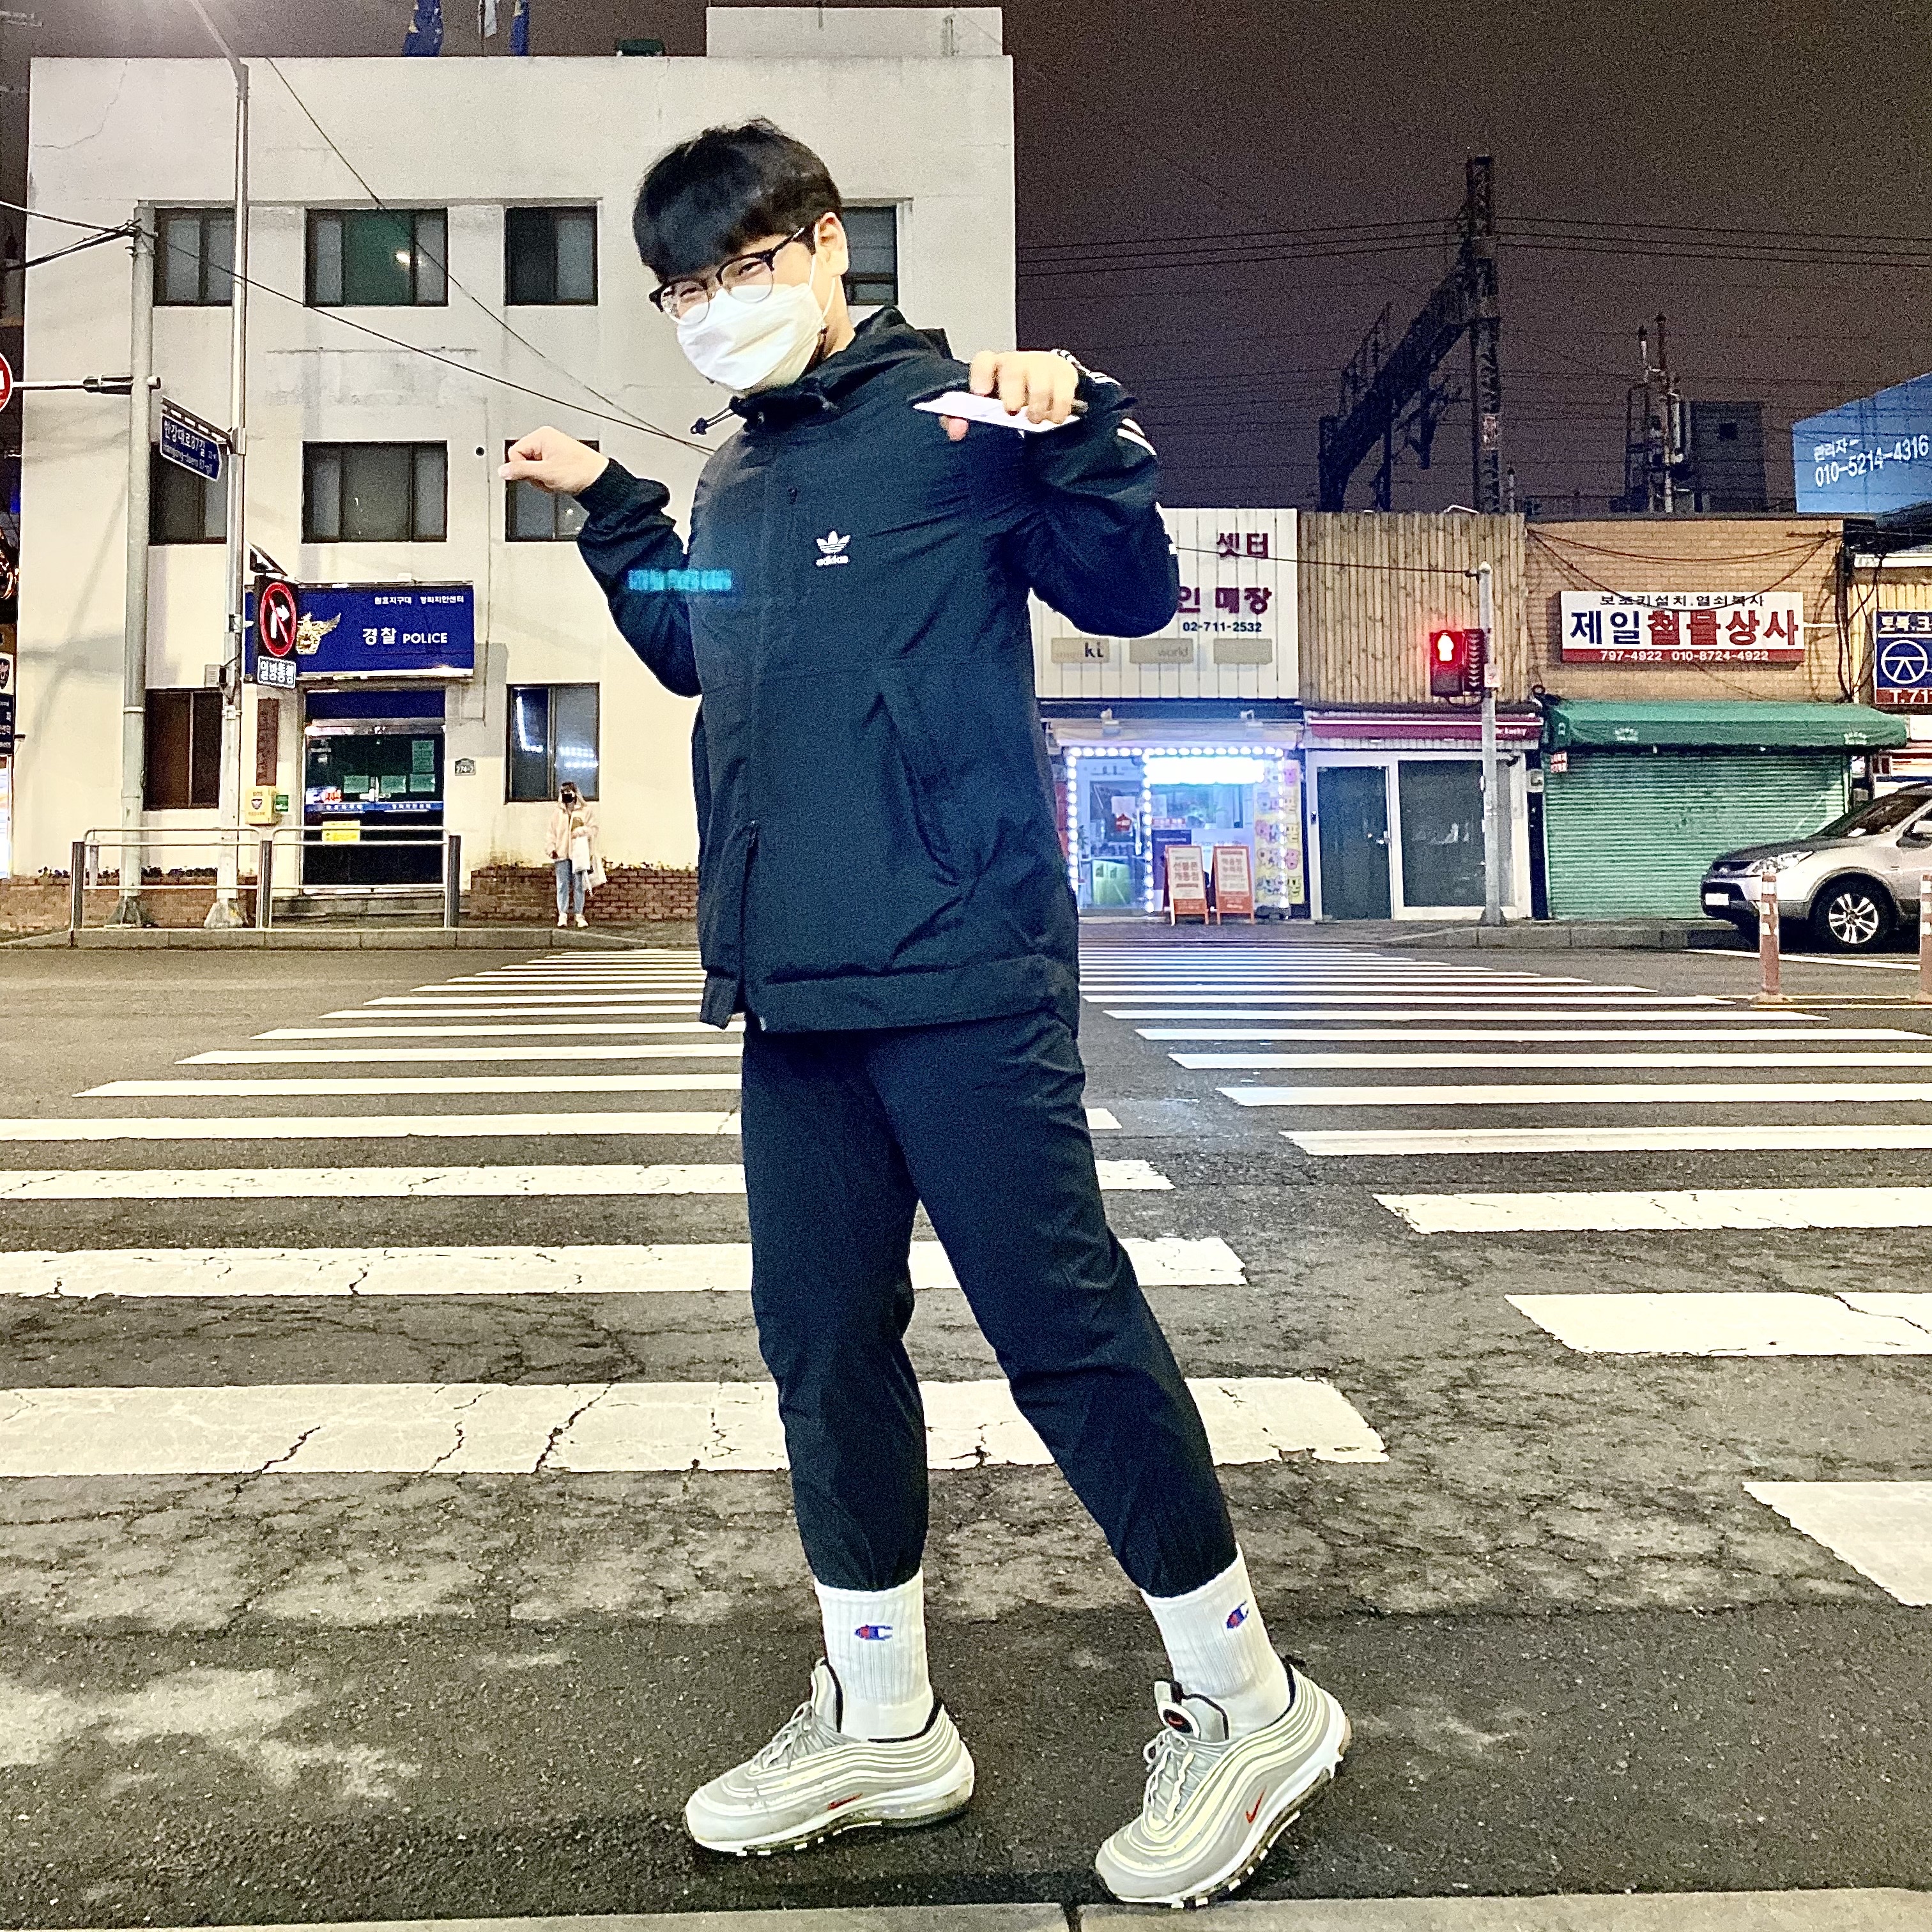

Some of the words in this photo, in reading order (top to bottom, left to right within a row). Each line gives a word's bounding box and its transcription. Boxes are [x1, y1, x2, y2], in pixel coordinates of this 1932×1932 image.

[1815, 434, 1929, 487] 010-5214-4316
[1215, 586, 1273, 615] 매장
[362, 627, 397, 645] 경찰
[402, 632, 448, 644] POLICE
[1183, 622, 1262, 632] 02-711-2532
[1570, 610, 1798, 646] 제일철물상사
[1600, 650, 1662, 661] 797-4922
[1671, 649, 1769, 661] 010-8724-4922
[1889, 689, 1932, 703] T.71
